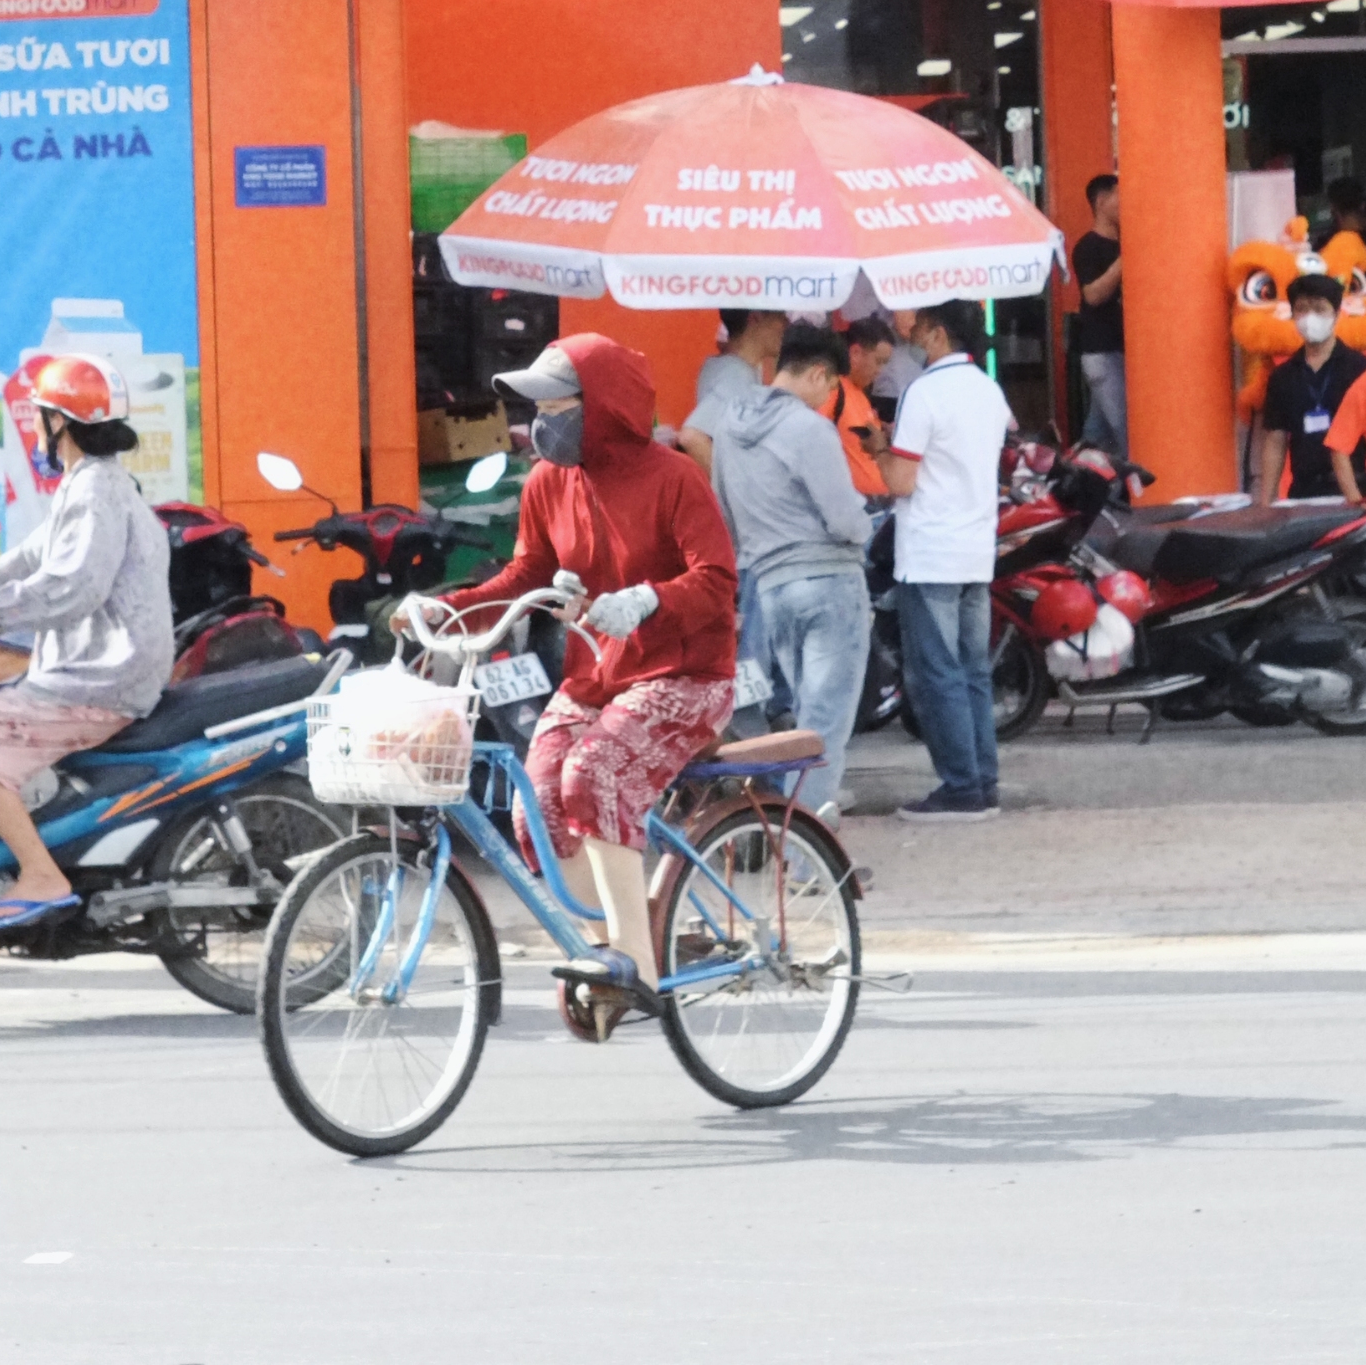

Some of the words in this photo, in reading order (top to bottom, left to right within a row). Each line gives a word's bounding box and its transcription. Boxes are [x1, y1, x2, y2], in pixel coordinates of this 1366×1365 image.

[75, 37, 171, 69] TƯƠI
[72, 124, 154, 160] NHÀ
[574, 162, 638, 185] NGON
[676, 164, 742, 192] SIÊU
[746, 169, 796, 195] THỊ
[896, 158, 980, 188] NGON
[484, 188, 544, 217] CHẤT
[644, 203, 723, 232] THỰC
[854, 196, 921, 230] CHẤT
